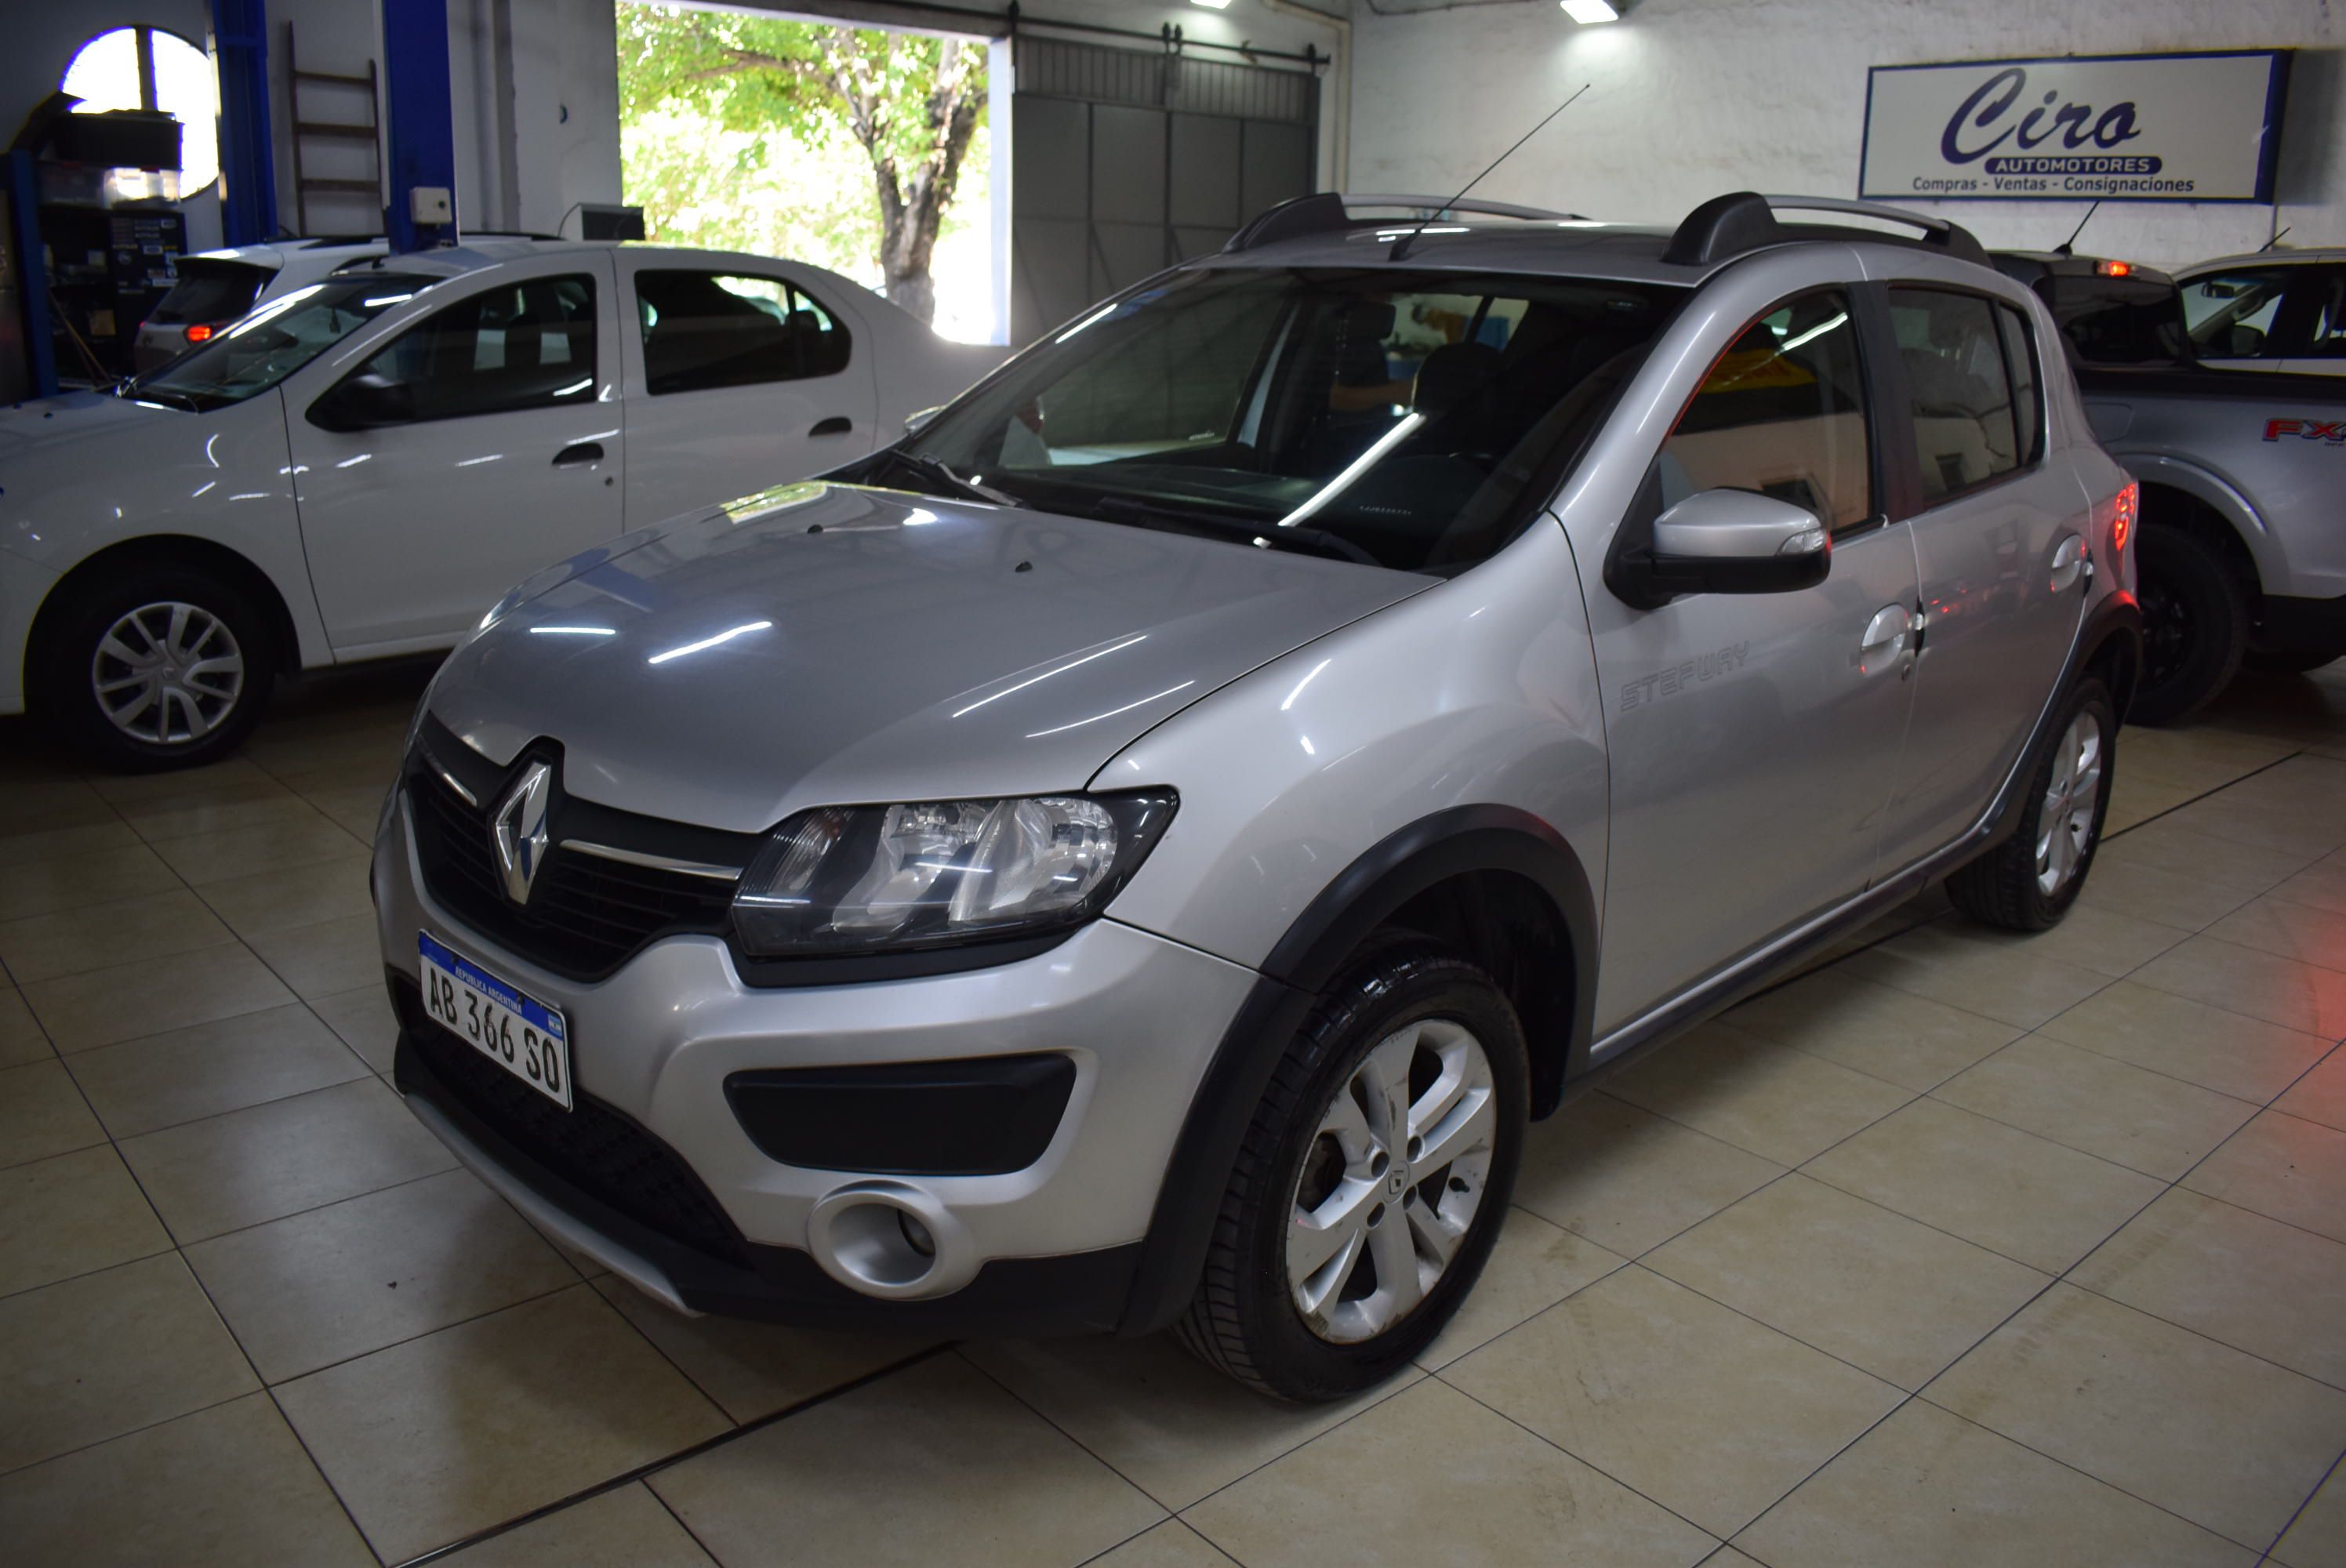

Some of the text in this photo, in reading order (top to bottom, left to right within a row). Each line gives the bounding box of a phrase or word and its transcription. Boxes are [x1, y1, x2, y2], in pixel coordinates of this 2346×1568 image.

[1941, 67, 2141, 165] Ciro
[1912, 176, 1978, 194] Compras
[1994, 177, 2047, 191] Ventas
[2064, 176, 2195, 194] Consignaciones
[1995, 158, 2150, 173] AUTOMOTORES
[2262, 419, 2346, 442] FX
[1620, 640, 1750, 713] STEPWAY
[455, 965, 522, 1016] REPUBLICA ARGENTINA
[430, 967, 560, 1094] AB 366 SO
